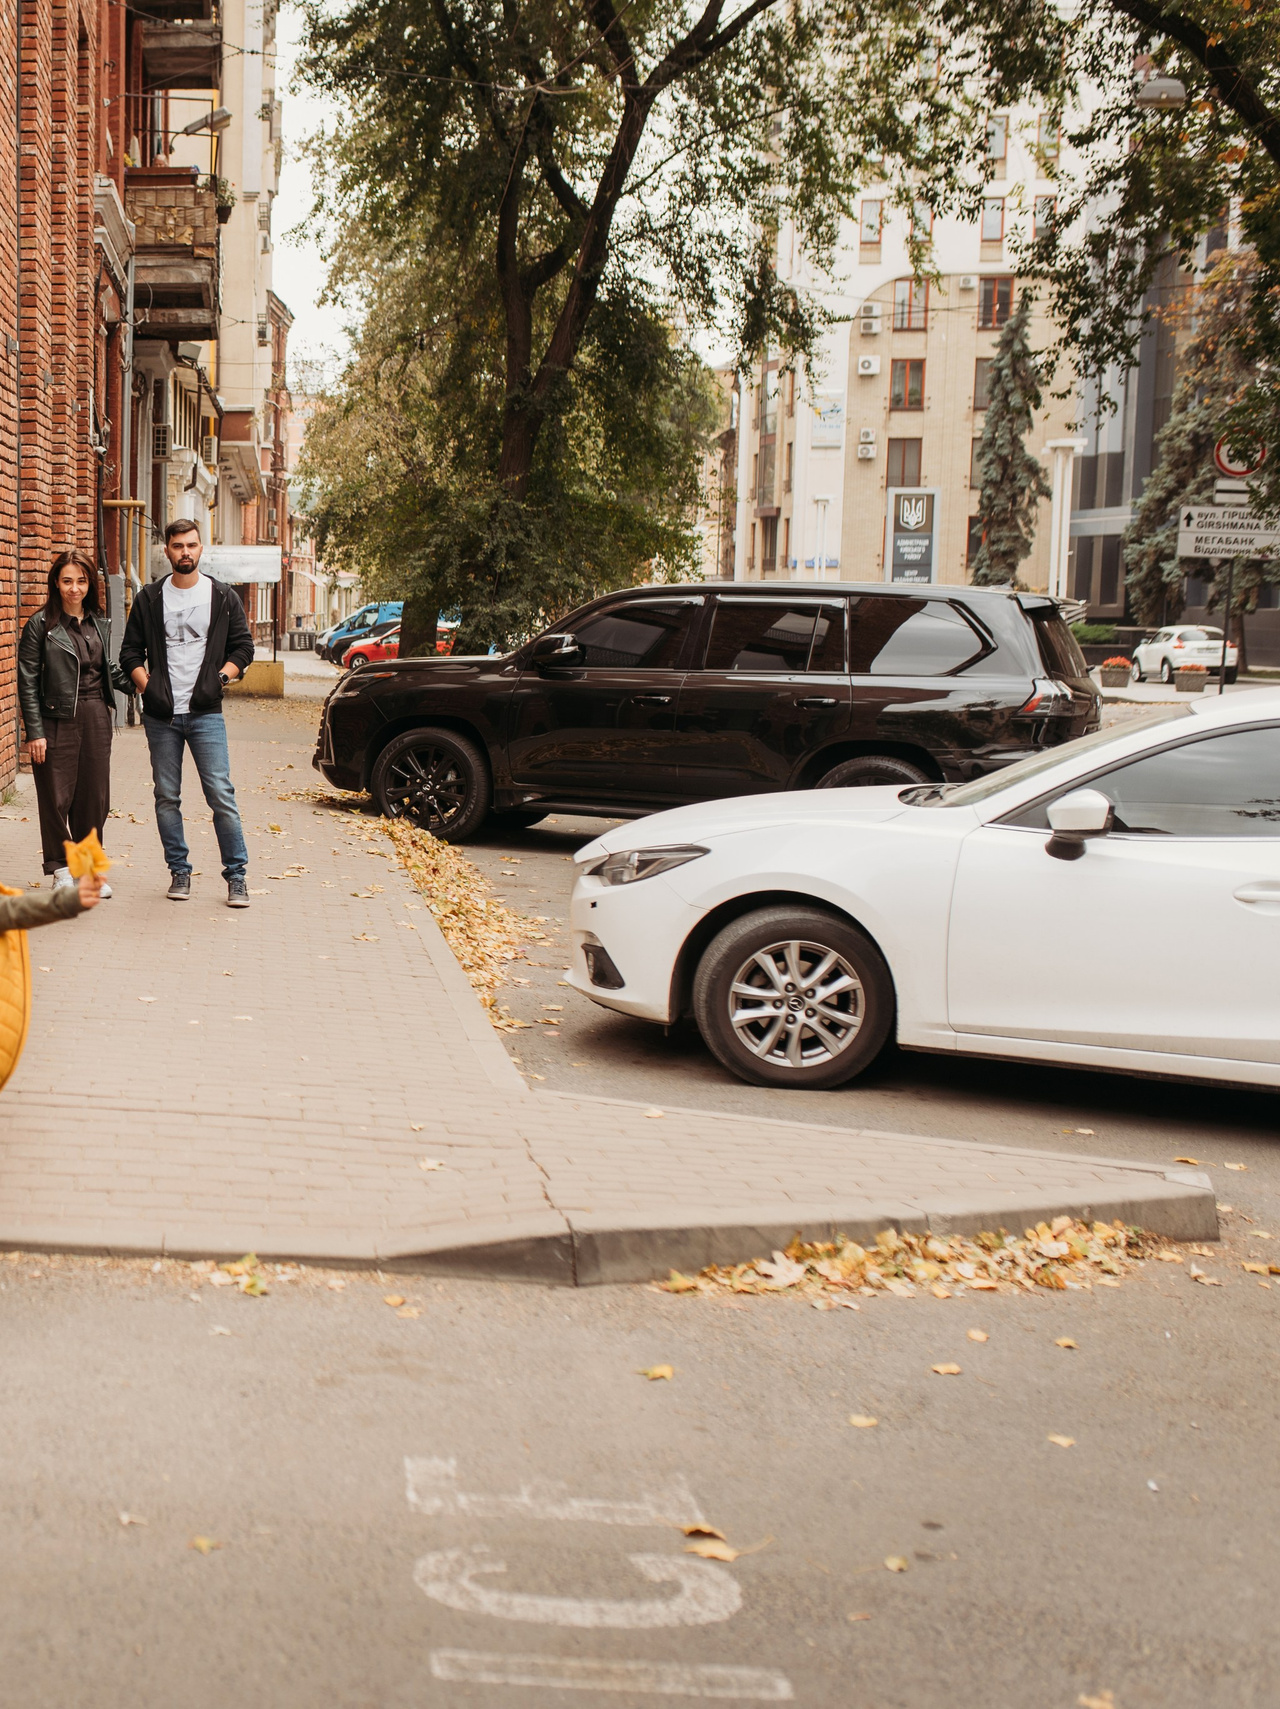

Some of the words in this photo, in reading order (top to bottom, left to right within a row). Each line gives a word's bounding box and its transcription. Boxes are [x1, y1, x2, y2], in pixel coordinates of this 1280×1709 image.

[1198, 512, 1218, 521] вул.
[1197, 521, 1261, 530] GIRSHMANA
[1195, 536, 1255, 545] МЕГАБАНК
[1194, 546, 1251, 555] Відділення
